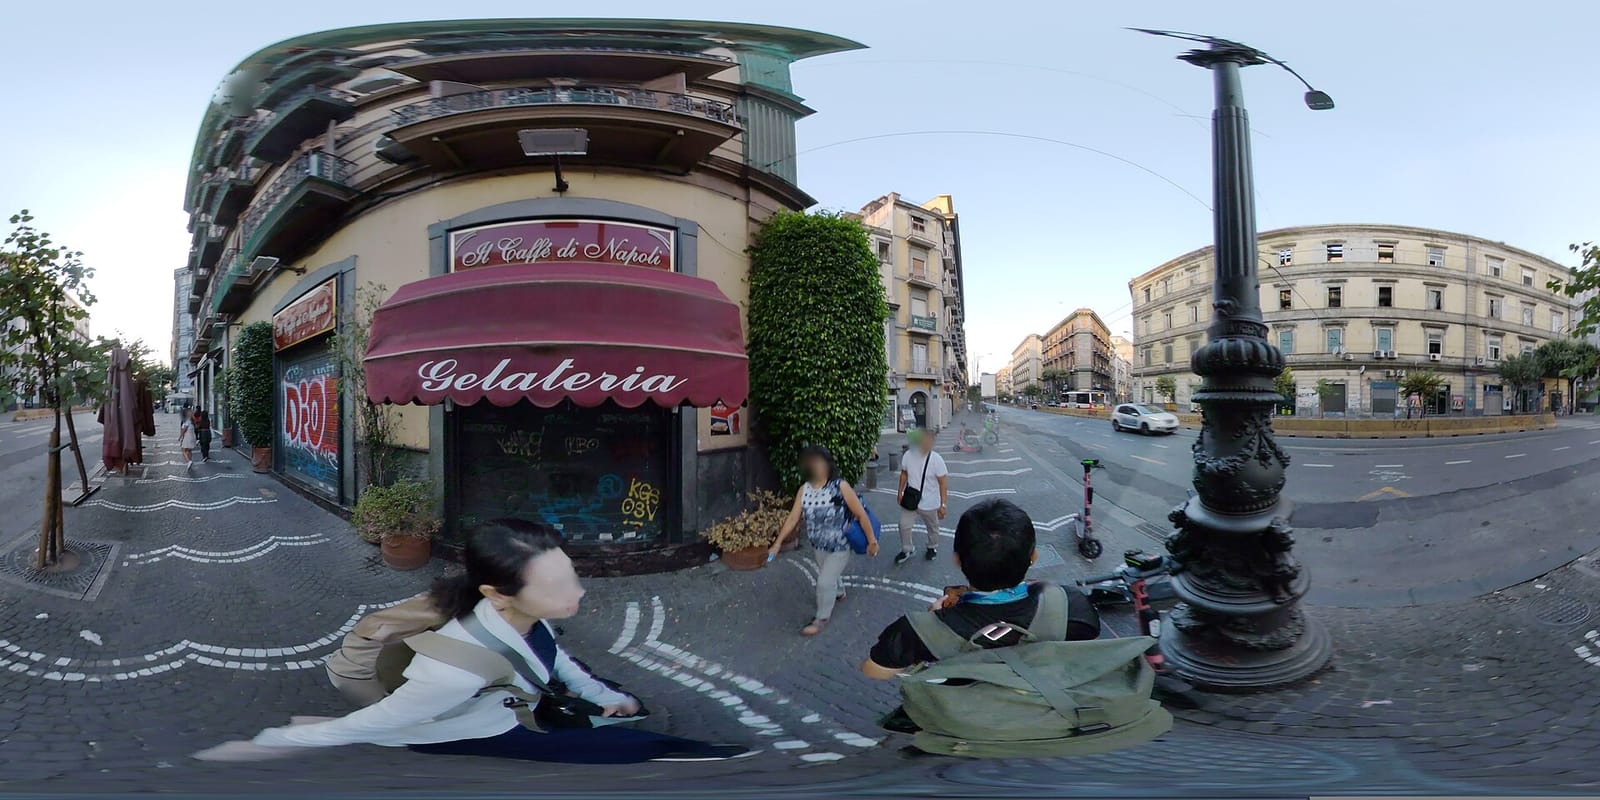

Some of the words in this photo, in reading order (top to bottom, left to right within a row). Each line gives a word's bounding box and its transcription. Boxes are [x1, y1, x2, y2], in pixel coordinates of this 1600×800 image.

[462, 241, 493, 267] Il
[557, 238, 579, 258] di
[584, 237, 663, 265] Napoli
[418, 358, 688, 393] Gelateria
